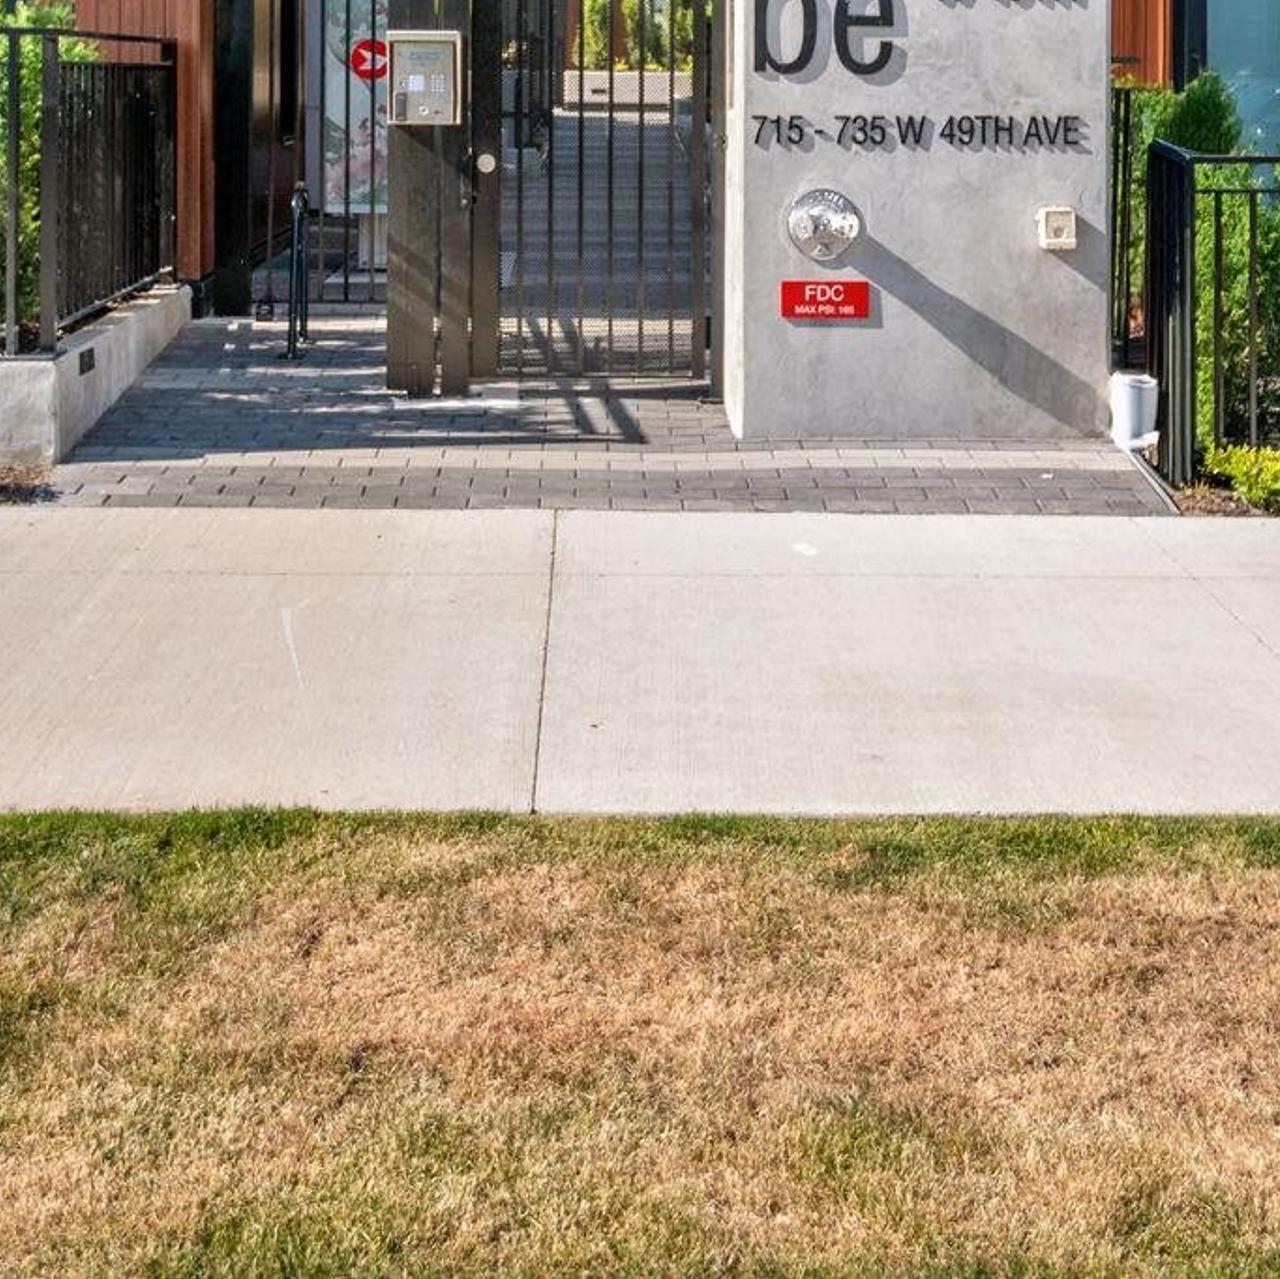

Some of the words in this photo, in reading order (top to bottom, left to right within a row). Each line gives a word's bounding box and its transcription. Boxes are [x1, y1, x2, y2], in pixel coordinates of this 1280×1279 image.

[751, 115, 805, 145] 715
[834, 115, 887, 145] 735
[896, 115, 926, 145] W
[939, 115, 1014, 145] 49TH
[1022, 115, 1081, 145] AVE
[804, 284, 845, 302] FDC
[794, 304, 817, 315] MAX
